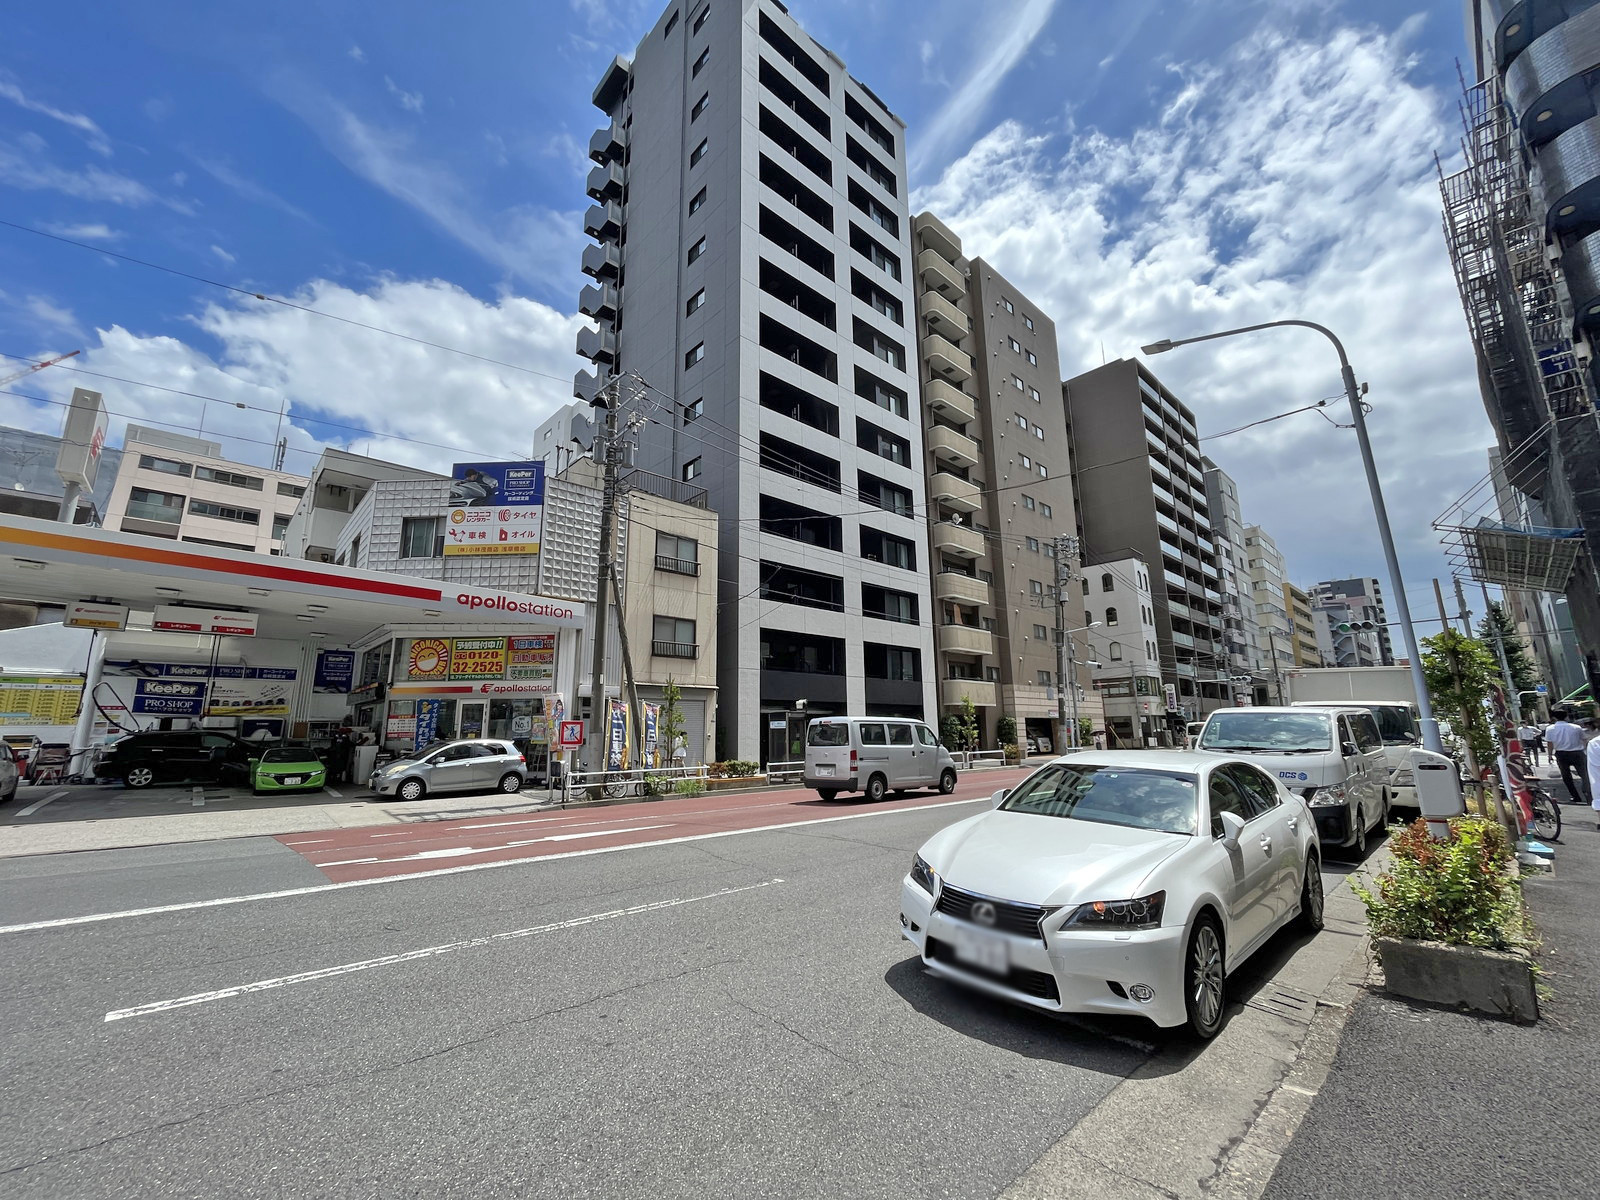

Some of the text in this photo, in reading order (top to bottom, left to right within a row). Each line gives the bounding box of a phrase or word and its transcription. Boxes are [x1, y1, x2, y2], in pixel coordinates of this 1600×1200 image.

[513, 511, 537, 519] タイヤ
[468, 531, 487, 539] 車検
[511, 530, 536, 538] オイル
[456, 593, 573, 619] apollostation
[171, 666, 207, 675] KeePer
[453, 661, 503, 673] 32-2525
[145, 681, 197, 695] KeePer
[145, 699, 193, 708] PRO SHOP
